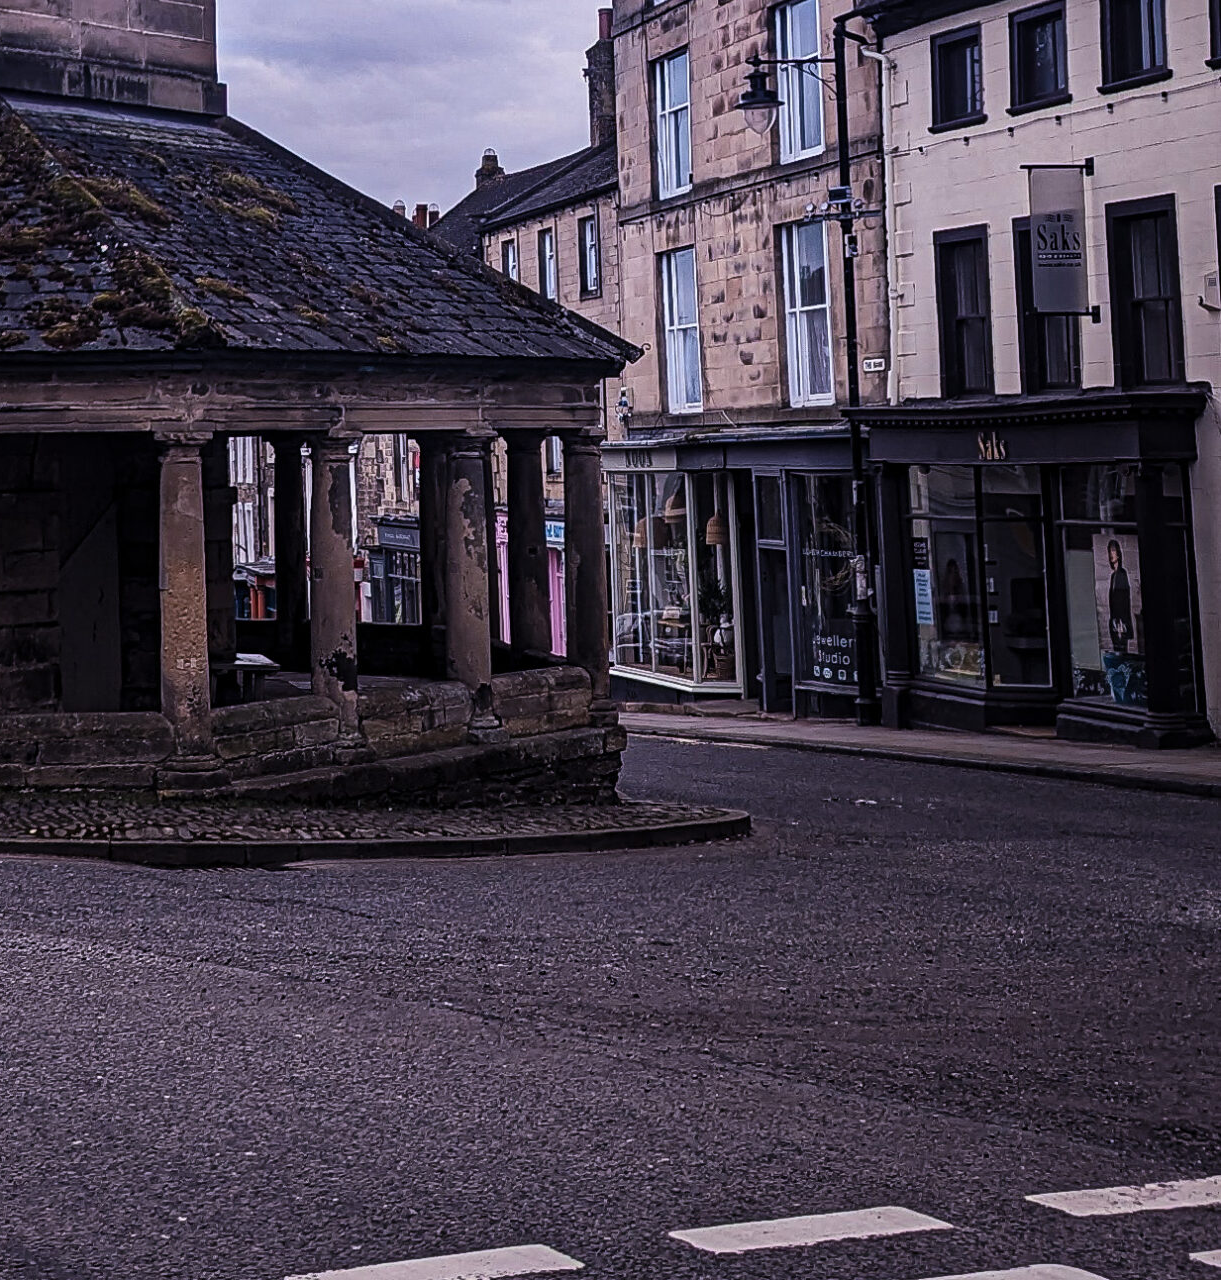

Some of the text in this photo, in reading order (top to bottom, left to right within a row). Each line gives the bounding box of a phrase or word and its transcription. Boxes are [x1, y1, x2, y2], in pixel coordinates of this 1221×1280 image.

[1037, 224, 1081, 250] Saks
[978, 431, 1006, 460] Saks
[818, 650, 851, 665] Studio
